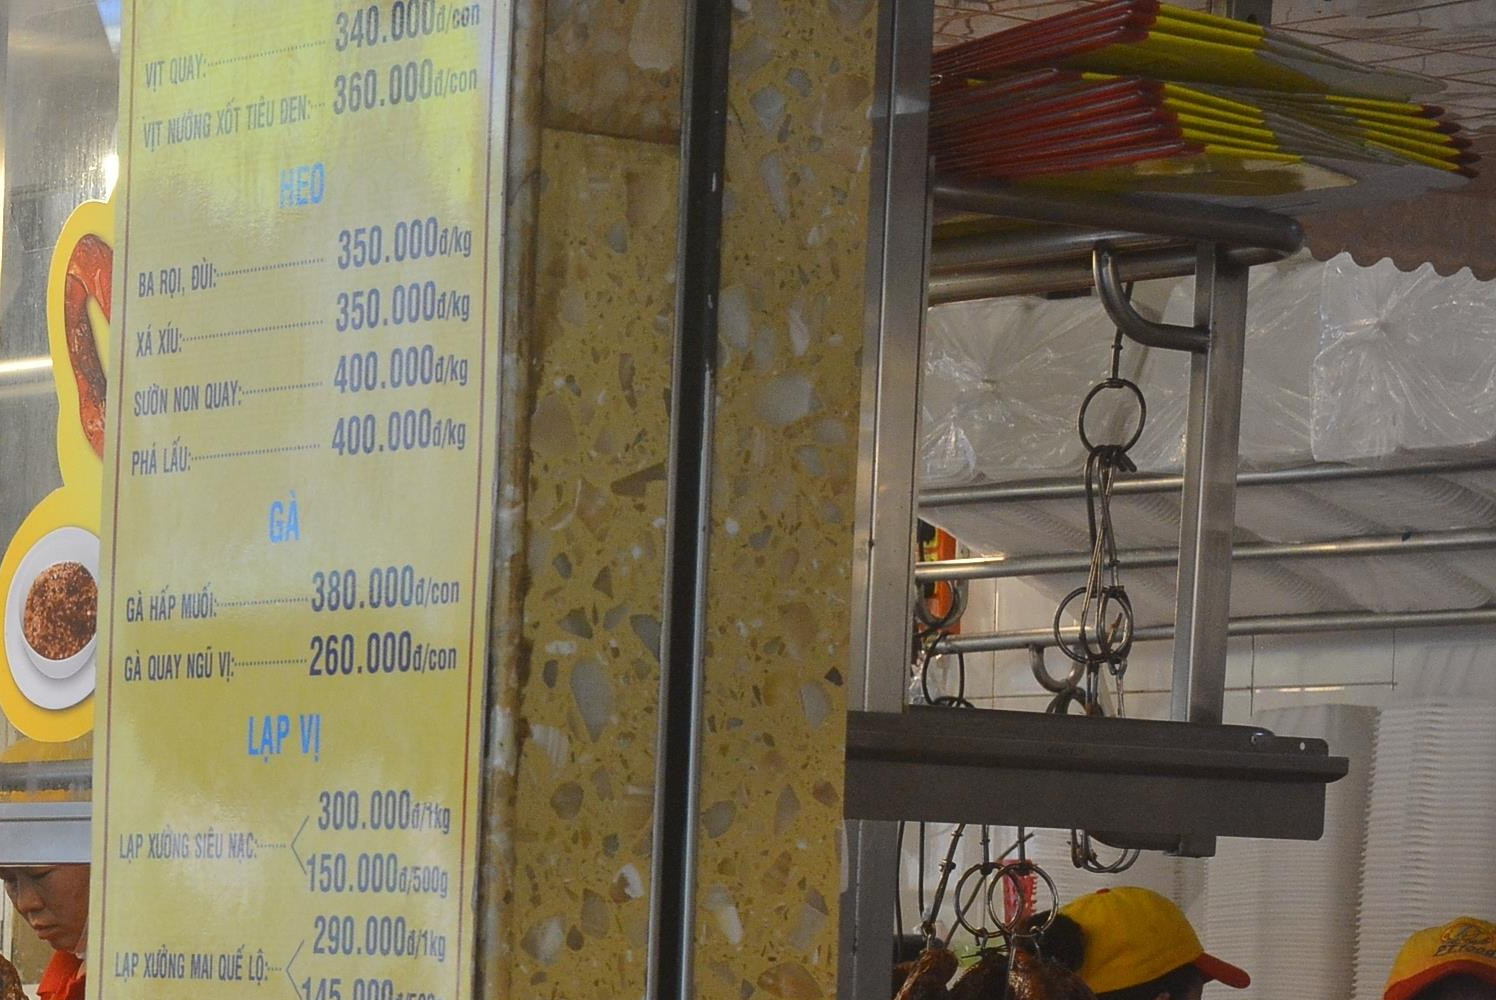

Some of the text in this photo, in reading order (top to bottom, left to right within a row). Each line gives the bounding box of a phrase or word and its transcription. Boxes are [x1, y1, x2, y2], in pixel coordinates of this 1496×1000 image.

[335, 0, 480, 52] 340.000đ/con
[145, 60, 165, 92] VỊT
[333, 58, 478, 115] 360.000đ/con
[143, 120, 163, 152] VỊT
[167, 109, 211, 144] NƯỚNG
[216, 97, 240, 135] XỐT
[246, 96, 275, 130] TIÊU
[280, 161, 325, 209] HEO
[337, 216, 473, 270] 350.000đ/kg
[138, 271, 154, 298] BA
[159, 267, 185, 298] RỌI,
[335, 280, 471, 333] 350.000đ/kg
[136, 324, 153, 357] XÁ
[334, 344, 468, 394] 400.000đ/kg
[134, 383, 169, 417] SƯỜN
[173, 385, 199, 413] NON
[331, 408, 467, 456] 400.000đ/kg
[131, 442, 157, 476] PHÁ
[269, 491, 301, 543] GÀ
[126, 590, 143, 622] GÀ
[150, 584, 176, 621] HẤP
[310, 565, 460, 612] 380.000đ/con
[124, 650, 142, 681] GÀ
[148, 653, 182, 681] QUAY
[186, 646, 213, 679] NGŨ
[309, 630, 457, 677] 260.000đ/con
[247, 713, 321, 762] LẠP VỊ
[317, 790, 451, 835] 300.000đ/1kg
[119, 833, 144, 864] LẠP
[148, 823, 189, 859] XƯỞNG
[195, 826, 223, 859] SIÊU
[305, 853, 448, 899] 150.000đ/500g
[313, 915, 445, 963] 290.000đ/1kg
[115, 952, 139, 983] LẠP
[143, 944, 185, 979] XƯỞNG
[190, 953, 213, 980] MAI
[218, 944, 245, 981] QUẾ
